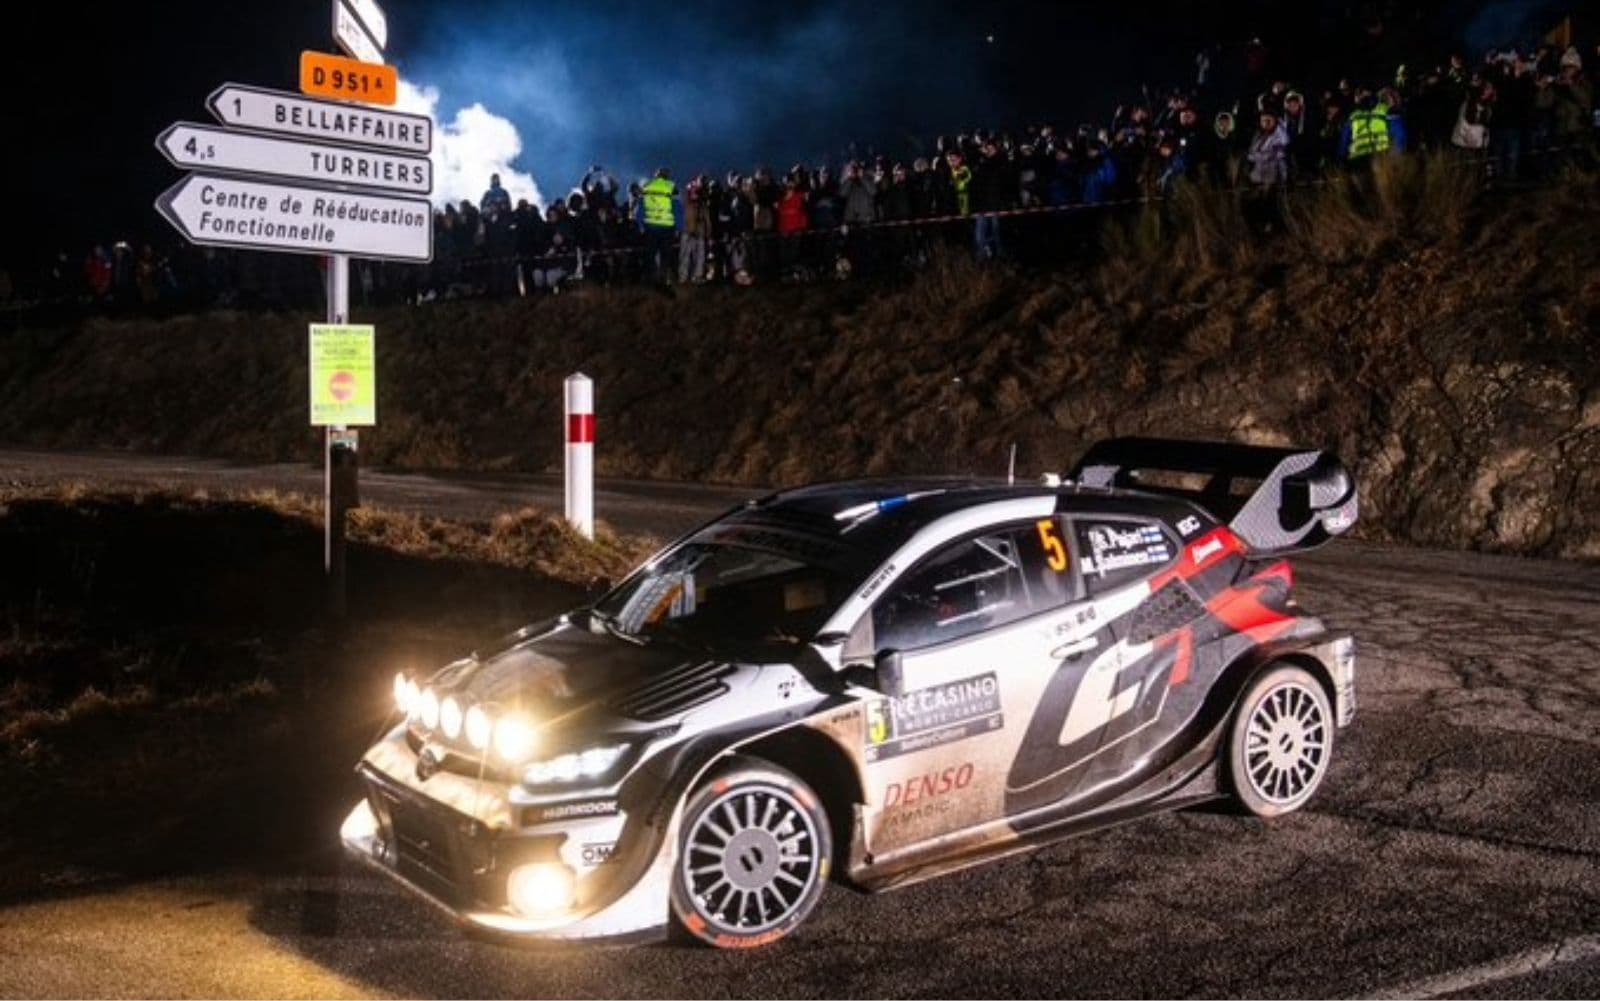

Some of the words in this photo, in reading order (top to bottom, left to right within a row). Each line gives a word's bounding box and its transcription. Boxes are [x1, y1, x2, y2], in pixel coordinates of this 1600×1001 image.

[233, 98, 242, 116] 1
[275, 104, 424, 143] BELLAFFAIRE
[311, 152, 424, 184] TURRIERS
[200, 211, 335, 243] Fonctionnelle
[201, 185, 267, 211] Centre
[280, 195, 302, 214] de
[313, 198, 424, 227] Rééducation
[1037, 518, 1067, 572] 5
[919, 676, 996, 711] CASINO
[883, 763, 974, 809] DENSO
